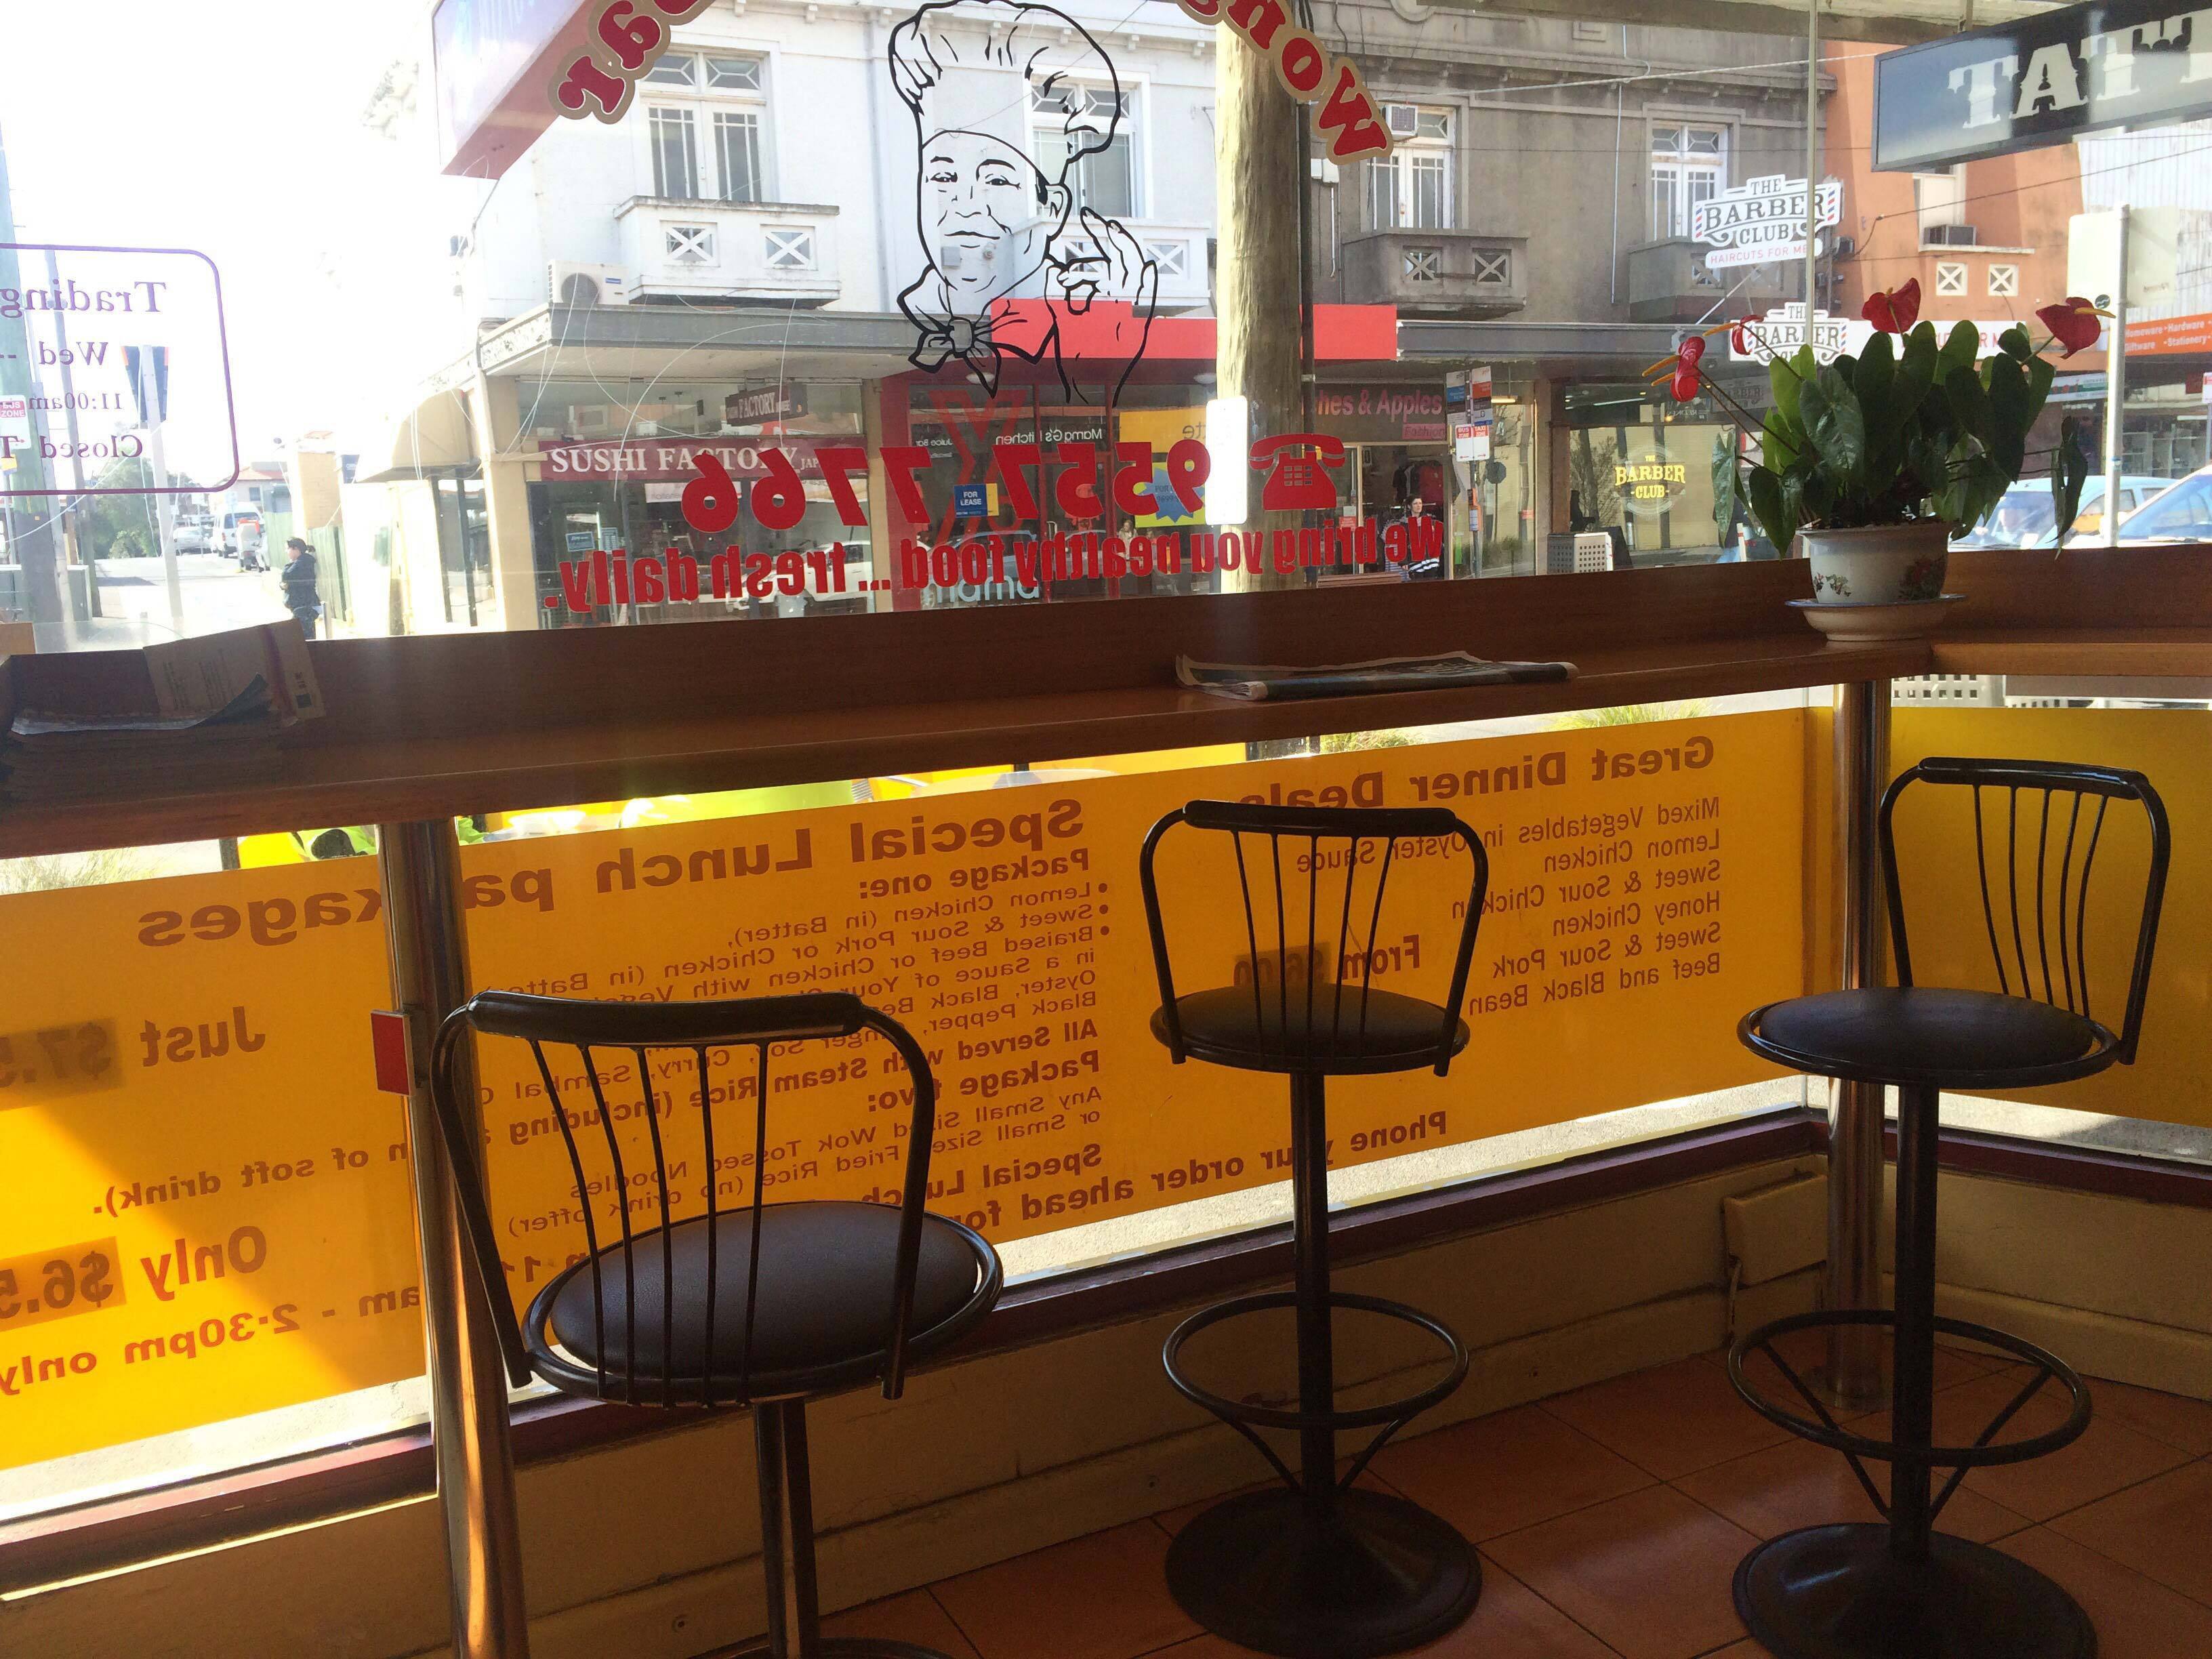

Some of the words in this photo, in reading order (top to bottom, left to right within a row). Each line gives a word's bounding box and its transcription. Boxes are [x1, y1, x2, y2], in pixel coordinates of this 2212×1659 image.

[1751, 178, 1782, 195] THE
[1704, 192, 1824, 232] BARBER
[1740, 224, 1789, 245] CLUB
[1711, 250, 1763, 265] HAIRCUTS
[1768, 248, 1789, 258] FOR
[1793, 245, 1807, 254] ME
[2167, 320, 2205, 333] Hardware
[2167, 334, 2207, 347] Stationery
[738, 392, 776, 419] FACTORY
[1357, 388, 1372, 415] &
[1376, 390, 1442, 423] Apples
[551, 447, 647, 473] SUSHI
[657, 447, 798, 472] FATOY
[1615, 464, 1686, 486] BARBER
